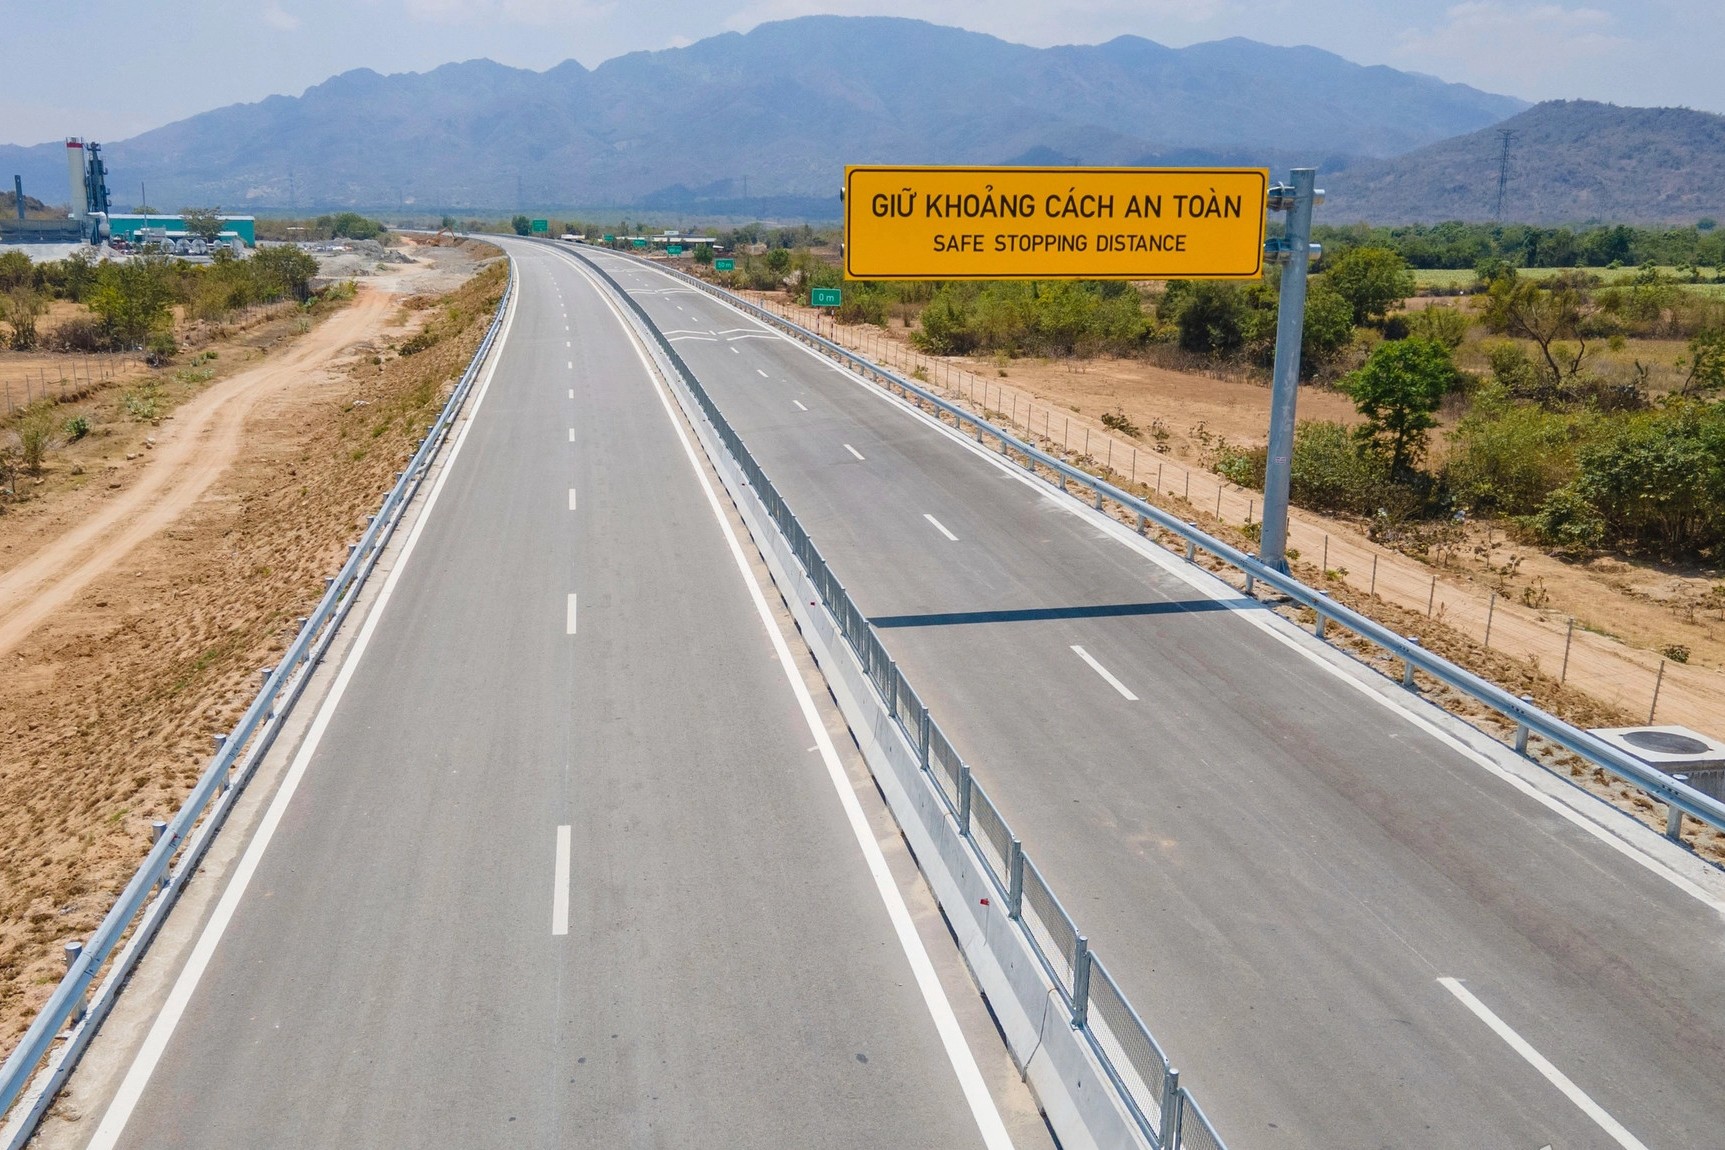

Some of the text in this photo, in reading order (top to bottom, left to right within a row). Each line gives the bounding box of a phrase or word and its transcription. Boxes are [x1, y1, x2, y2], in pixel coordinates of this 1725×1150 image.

[871, 184, 1241, 218] GIỮ KHOẢNG CÁCH AN TOÀN
[933, 234, 1186, 251] SAFE STOPPING DISTANCE
[818, 293, 824, 302] 0
